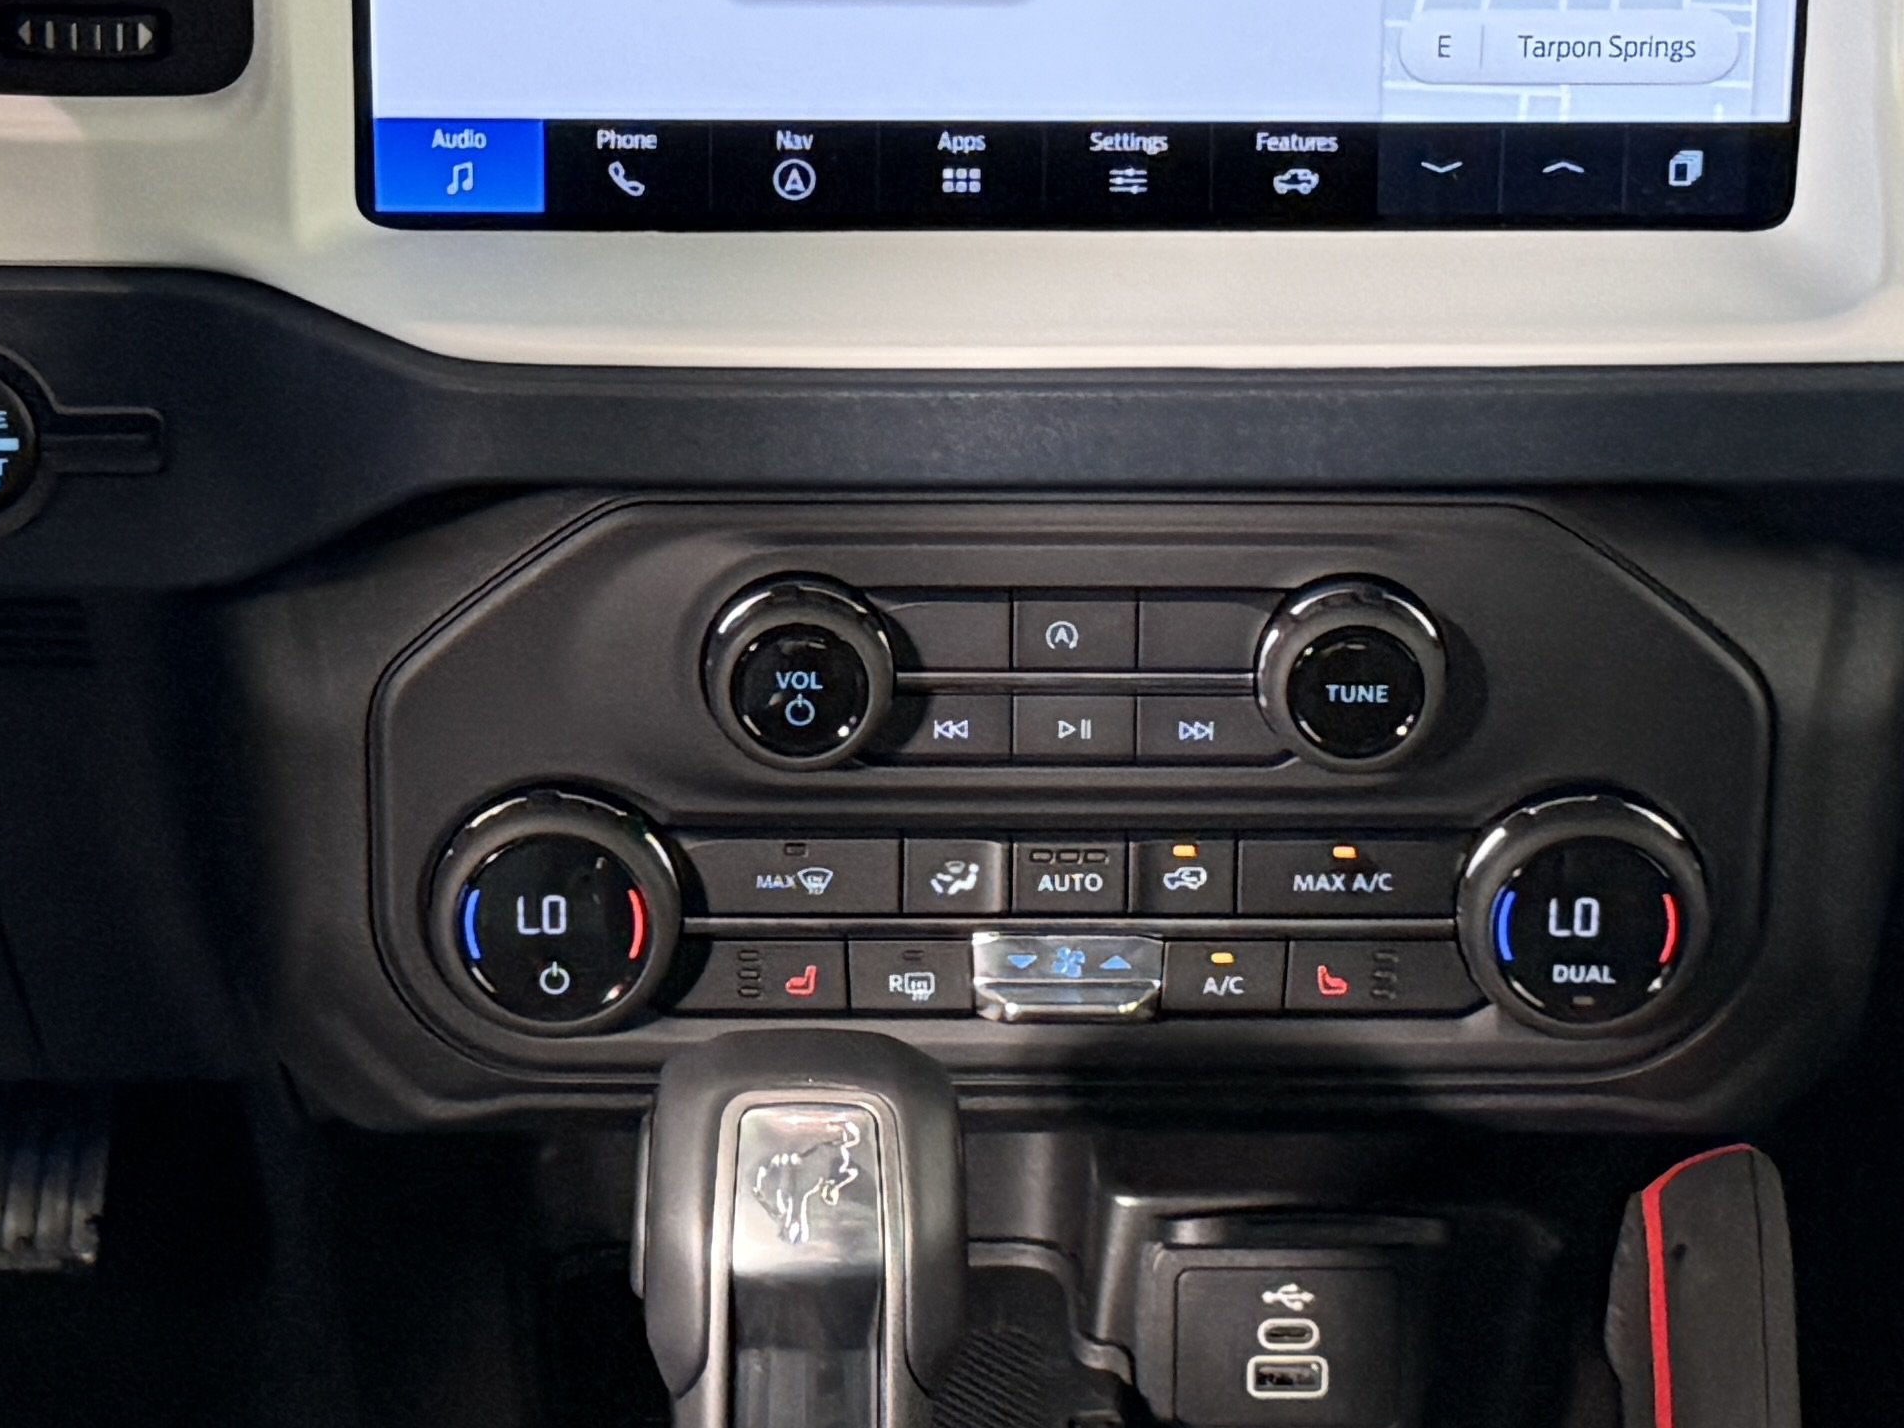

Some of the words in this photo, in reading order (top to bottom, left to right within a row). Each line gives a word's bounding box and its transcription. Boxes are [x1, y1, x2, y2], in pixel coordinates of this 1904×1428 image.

[1437, 34, 1452, 59] E
[1517, 34, 1602, 63] Tarpon
[1608, 34, 1697, 63] Springs
[431, 128, 487, 149] Audio
[596, 128, 658, 150] Phone
[776, 129, 814, 151] Nav
[937, 130, 987, 154] Apps
[1089, 131, 1169, 156] Settings
[1255, 131, 1339, 153] Features
[775, 670, 824, 690] VOL
[1325, 684, 1389, 704] TUNE
[756, 874, 796, 889] MAX
[1037, 873, 1104, 892] AUTO
[1293, 873, 1346, 892] MAX
[1351, 872, 1393, 893] A/C
[516, 894, 567, 936] LO
[1548, 896, 1600, 938] LO
[1552, 964, 1616, 984] DUAL
[1202, 975, 1244, 996] A/C
